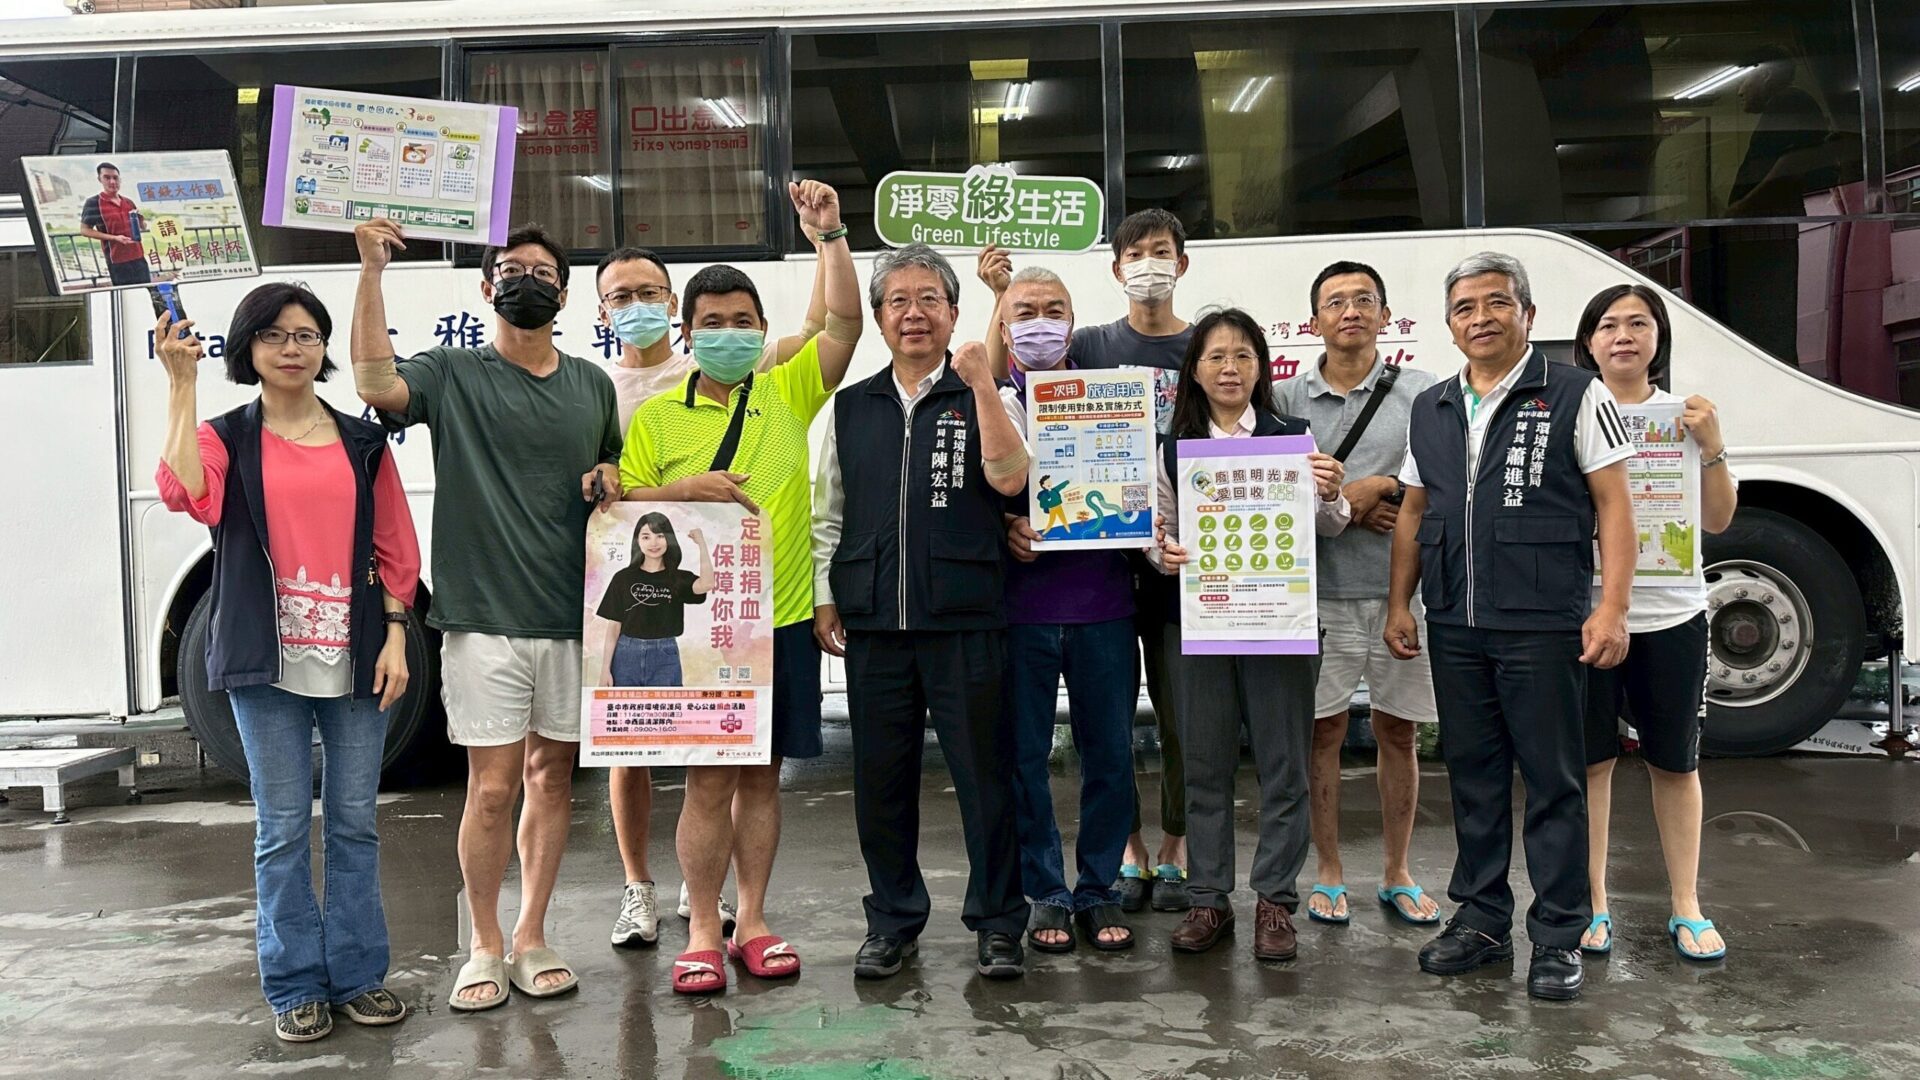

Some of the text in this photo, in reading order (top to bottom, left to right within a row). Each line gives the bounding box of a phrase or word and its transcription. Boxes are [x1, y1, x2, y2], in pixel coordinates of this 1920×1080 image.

[143, 183, 220, 199] 省錢大作戰
[889, 173, 1086, 226] 淨零綠生活
[157, 220, 178, 237] 請
[911, 223, 1060, 248] Green Lifestyle
[148, 240, 243, 265] 自備環保杯
[1040, 381, 1145, 399] 一次用 旅宿用品
[1039, 400, 1143, 414] 限制使用對象及實施方式
[951, 429, 967, 489] 環境保護局
[1502, 421, 1529, 507] 隊長 蕭進益
[1528, 421, 1551, 488] 環境保護局
[930, 428, 948, 508] 局長 陳宏益
[1215, 468, 1299, 485] 廢照明光源
[1217, 486, 1265, 501] 愛回收
[739, 517, 761, 620] 定期捐血
[711, 543, 735, 649] 保障你我
